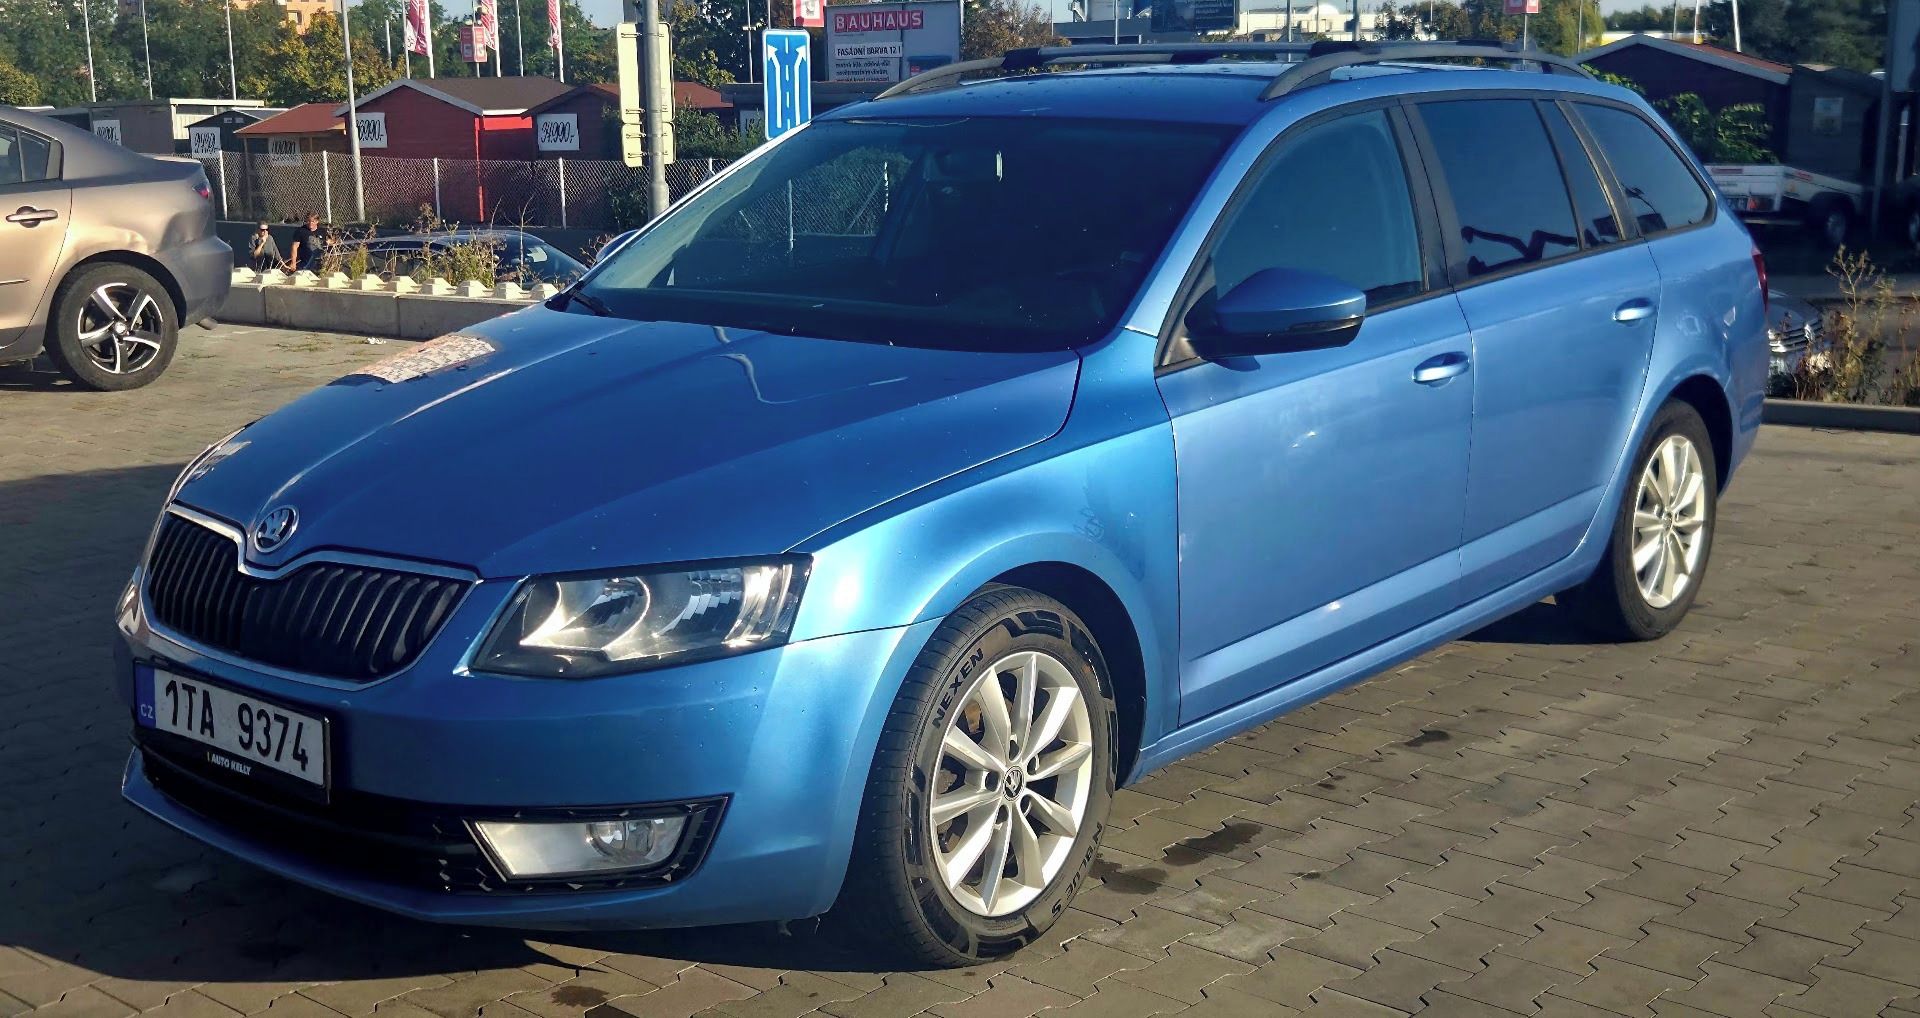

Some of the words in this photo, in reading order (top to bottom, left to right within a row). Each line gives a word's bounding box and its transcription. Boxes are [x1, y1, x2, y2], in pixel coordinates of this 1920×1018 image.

[836, 11, 922, 31] BAUHAUS
[932, 647, 984, 729] NEXEN
[140, 703, 154, 719] CZ
[165, 679, 215, 739] 1TA
[237, 702, 309, 772] 9374
[211, 753, 230, 768] AUTO
[230, 760, 252, 776] KELLY
